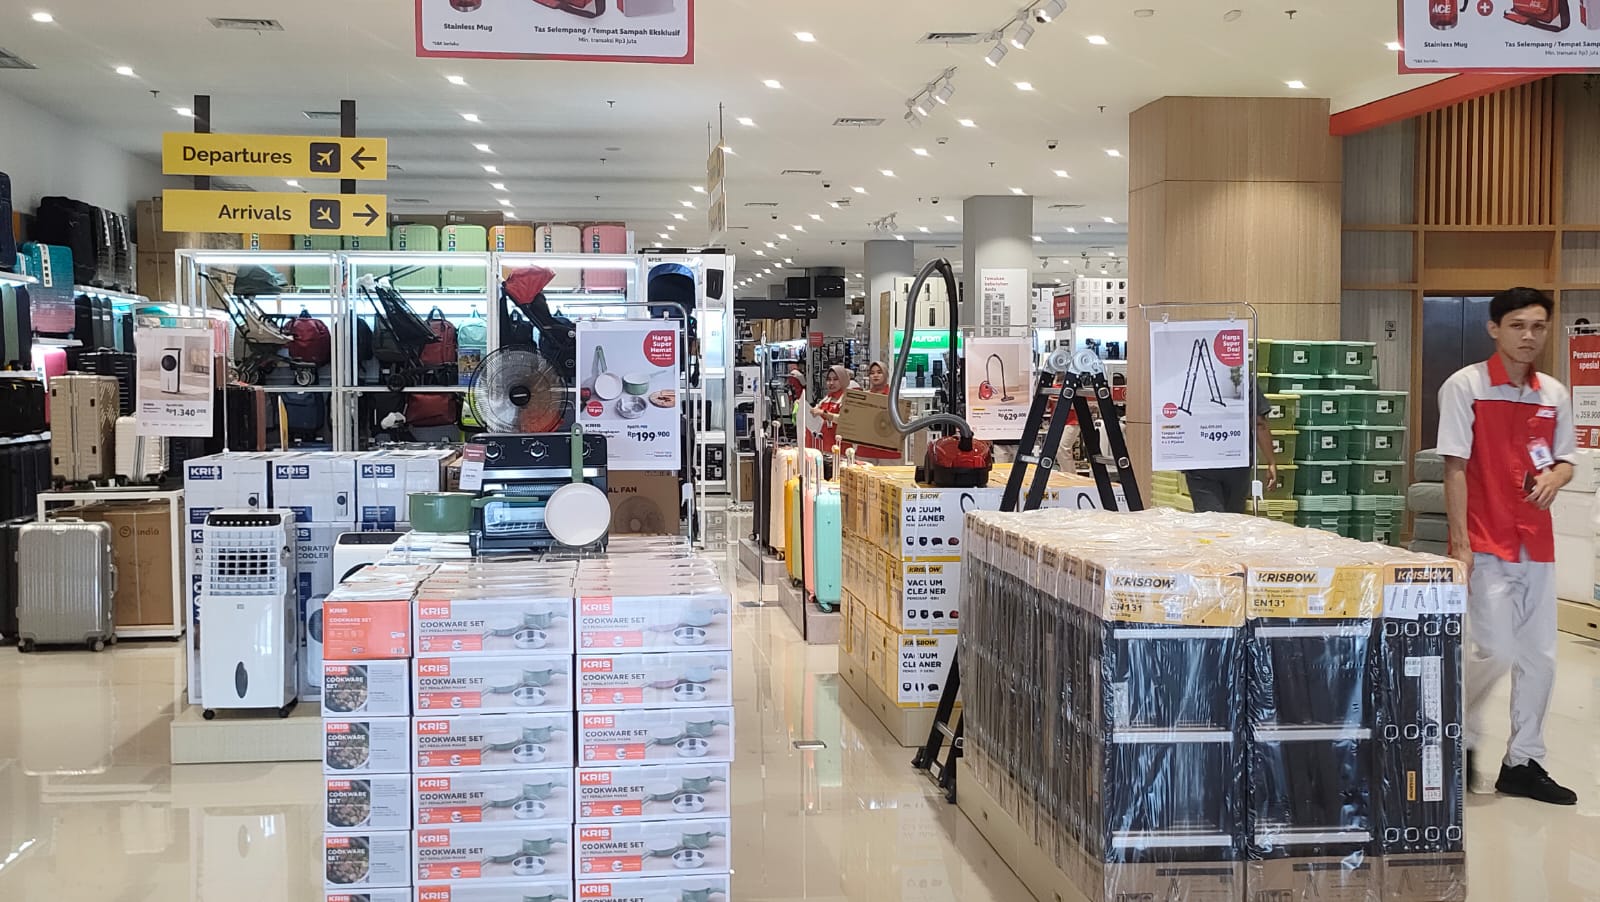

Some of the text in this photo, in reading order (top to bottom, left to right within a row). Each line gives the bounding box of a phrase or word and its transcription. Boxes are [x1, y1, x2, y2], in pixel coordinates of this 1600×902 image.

[1432, 2, 1451, 14] ACE
[444, 23, 493, 32] Stainless Mug
[547, 27, 586, 35] Selempang
[182, 146, 292, 166] Departures
[218, 204, 292, 221] Arrivals
[1579, 361, 1600, 371] spesial
[627, 431, 670, 441] Rp199.900
[1201, 431, 1241, 441] Rp499.900
[1258, 573, 1317, 582] KRISBOW
[1398, 571, 1451, 580] KRISBOW
[1115, 576, 1175, 588] KRISBOW
[1110, 603, 1142, 612] EN131
